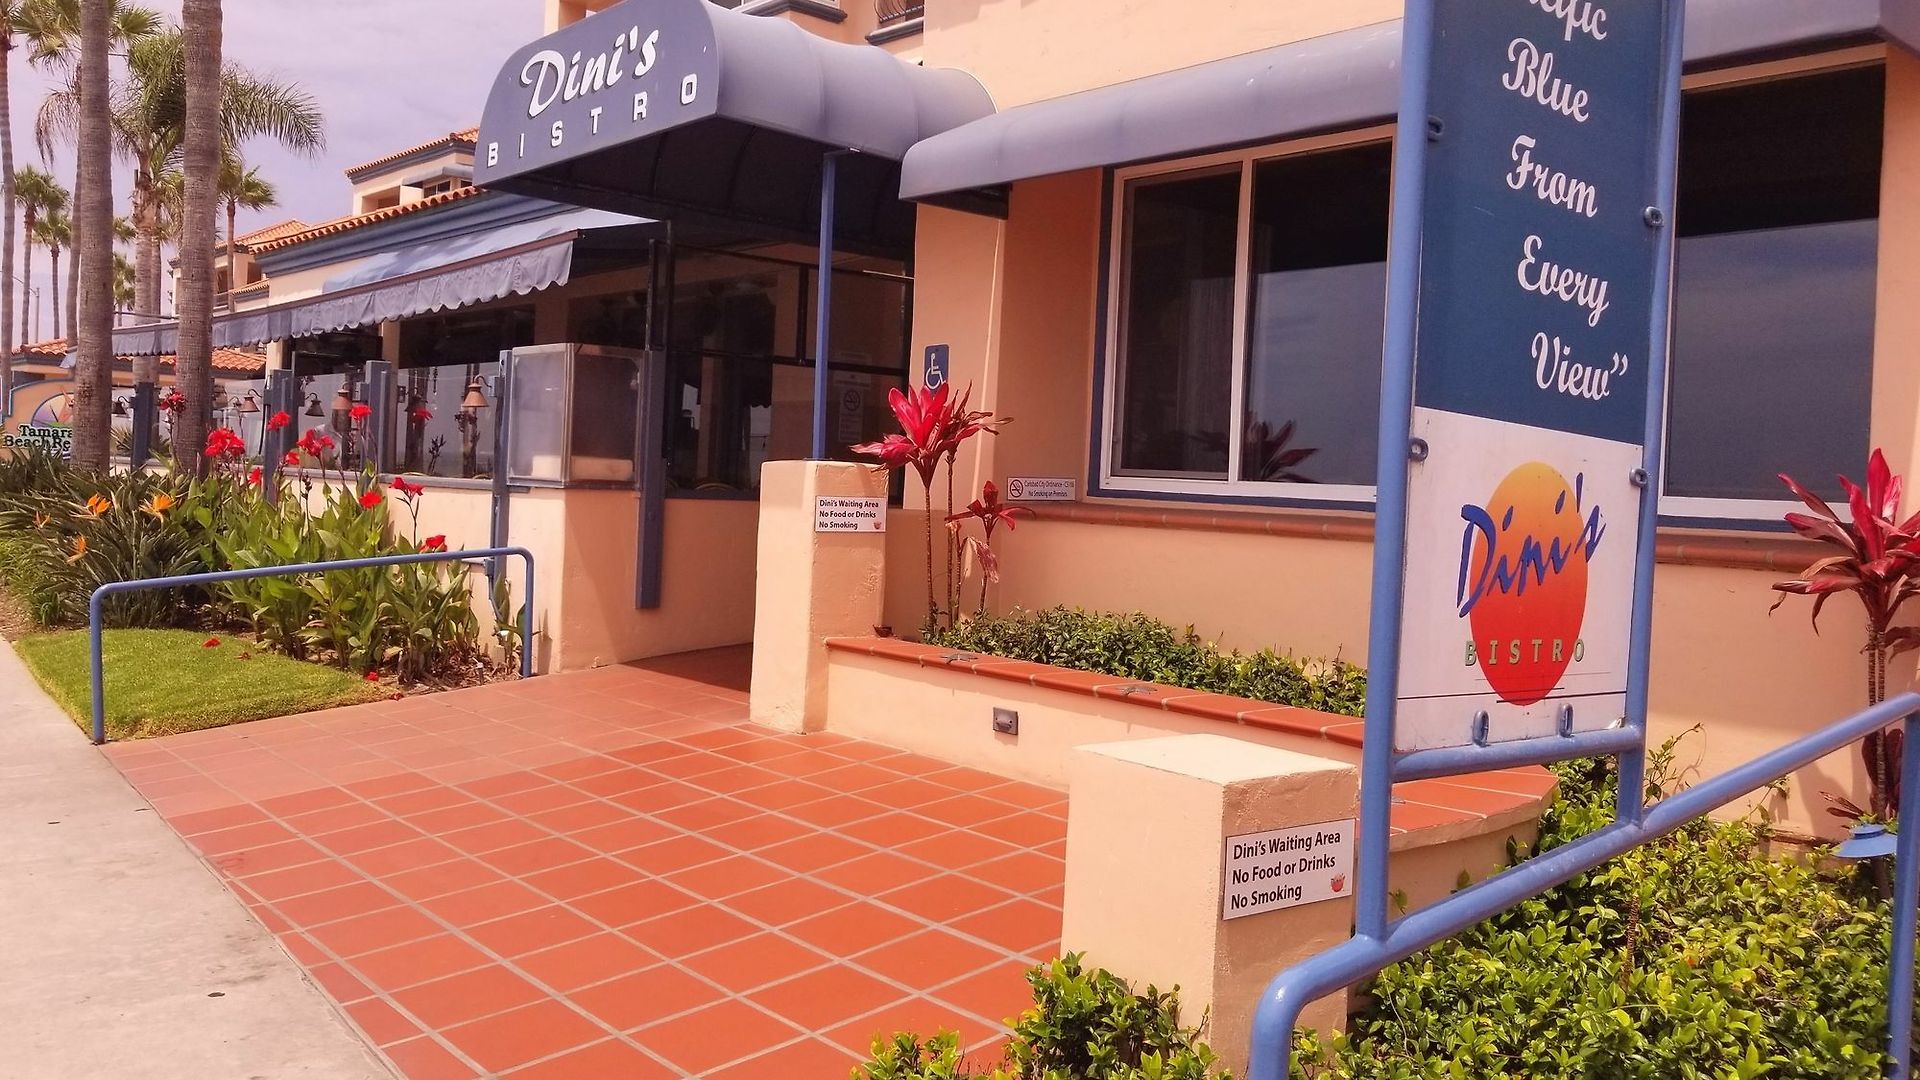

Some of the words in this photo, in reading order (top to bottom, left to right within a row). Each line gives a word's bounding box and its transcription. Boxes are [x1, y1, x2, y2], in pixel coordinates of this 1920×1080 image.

[520, 25, 659, 118] Dini's
[1502, 37, 1589, 122] Blue
[487, 73, 697, 167] BISTRO
[1506, 134, 1598, 217] From
[1517, 235, 1610, 327] Every
[19, 424, 73, 438] Tamara
[819, 510, 829, 518] No
[829, 510, 847, 518] Food
[855, 510, 877, 518] Drinks
[838, 499, 863, 509] Waiting
[864, 500, 879, 508] Area
[818, 520, 829, 528] No
[829, 520, 859, 530] Smoking
[1456, 472, 1607, 618] Dini's
[1464, 638, 1585, 667] BISTRO
[1233, 841, 1266, 860] Dini’s
[1268, 835, 1312, 854] Waiting
[1314, 831, 1341, 847] Area
[1232, 868, 1249, 885] No
[1252, 861, 1281, 882] Food
[1283, 863, 1297, 875] or
[1299, 853, 1336, 873] Drinks
[1231, 893, 1248, 910] No
[1250, 884, 1302, 906] Smoking
